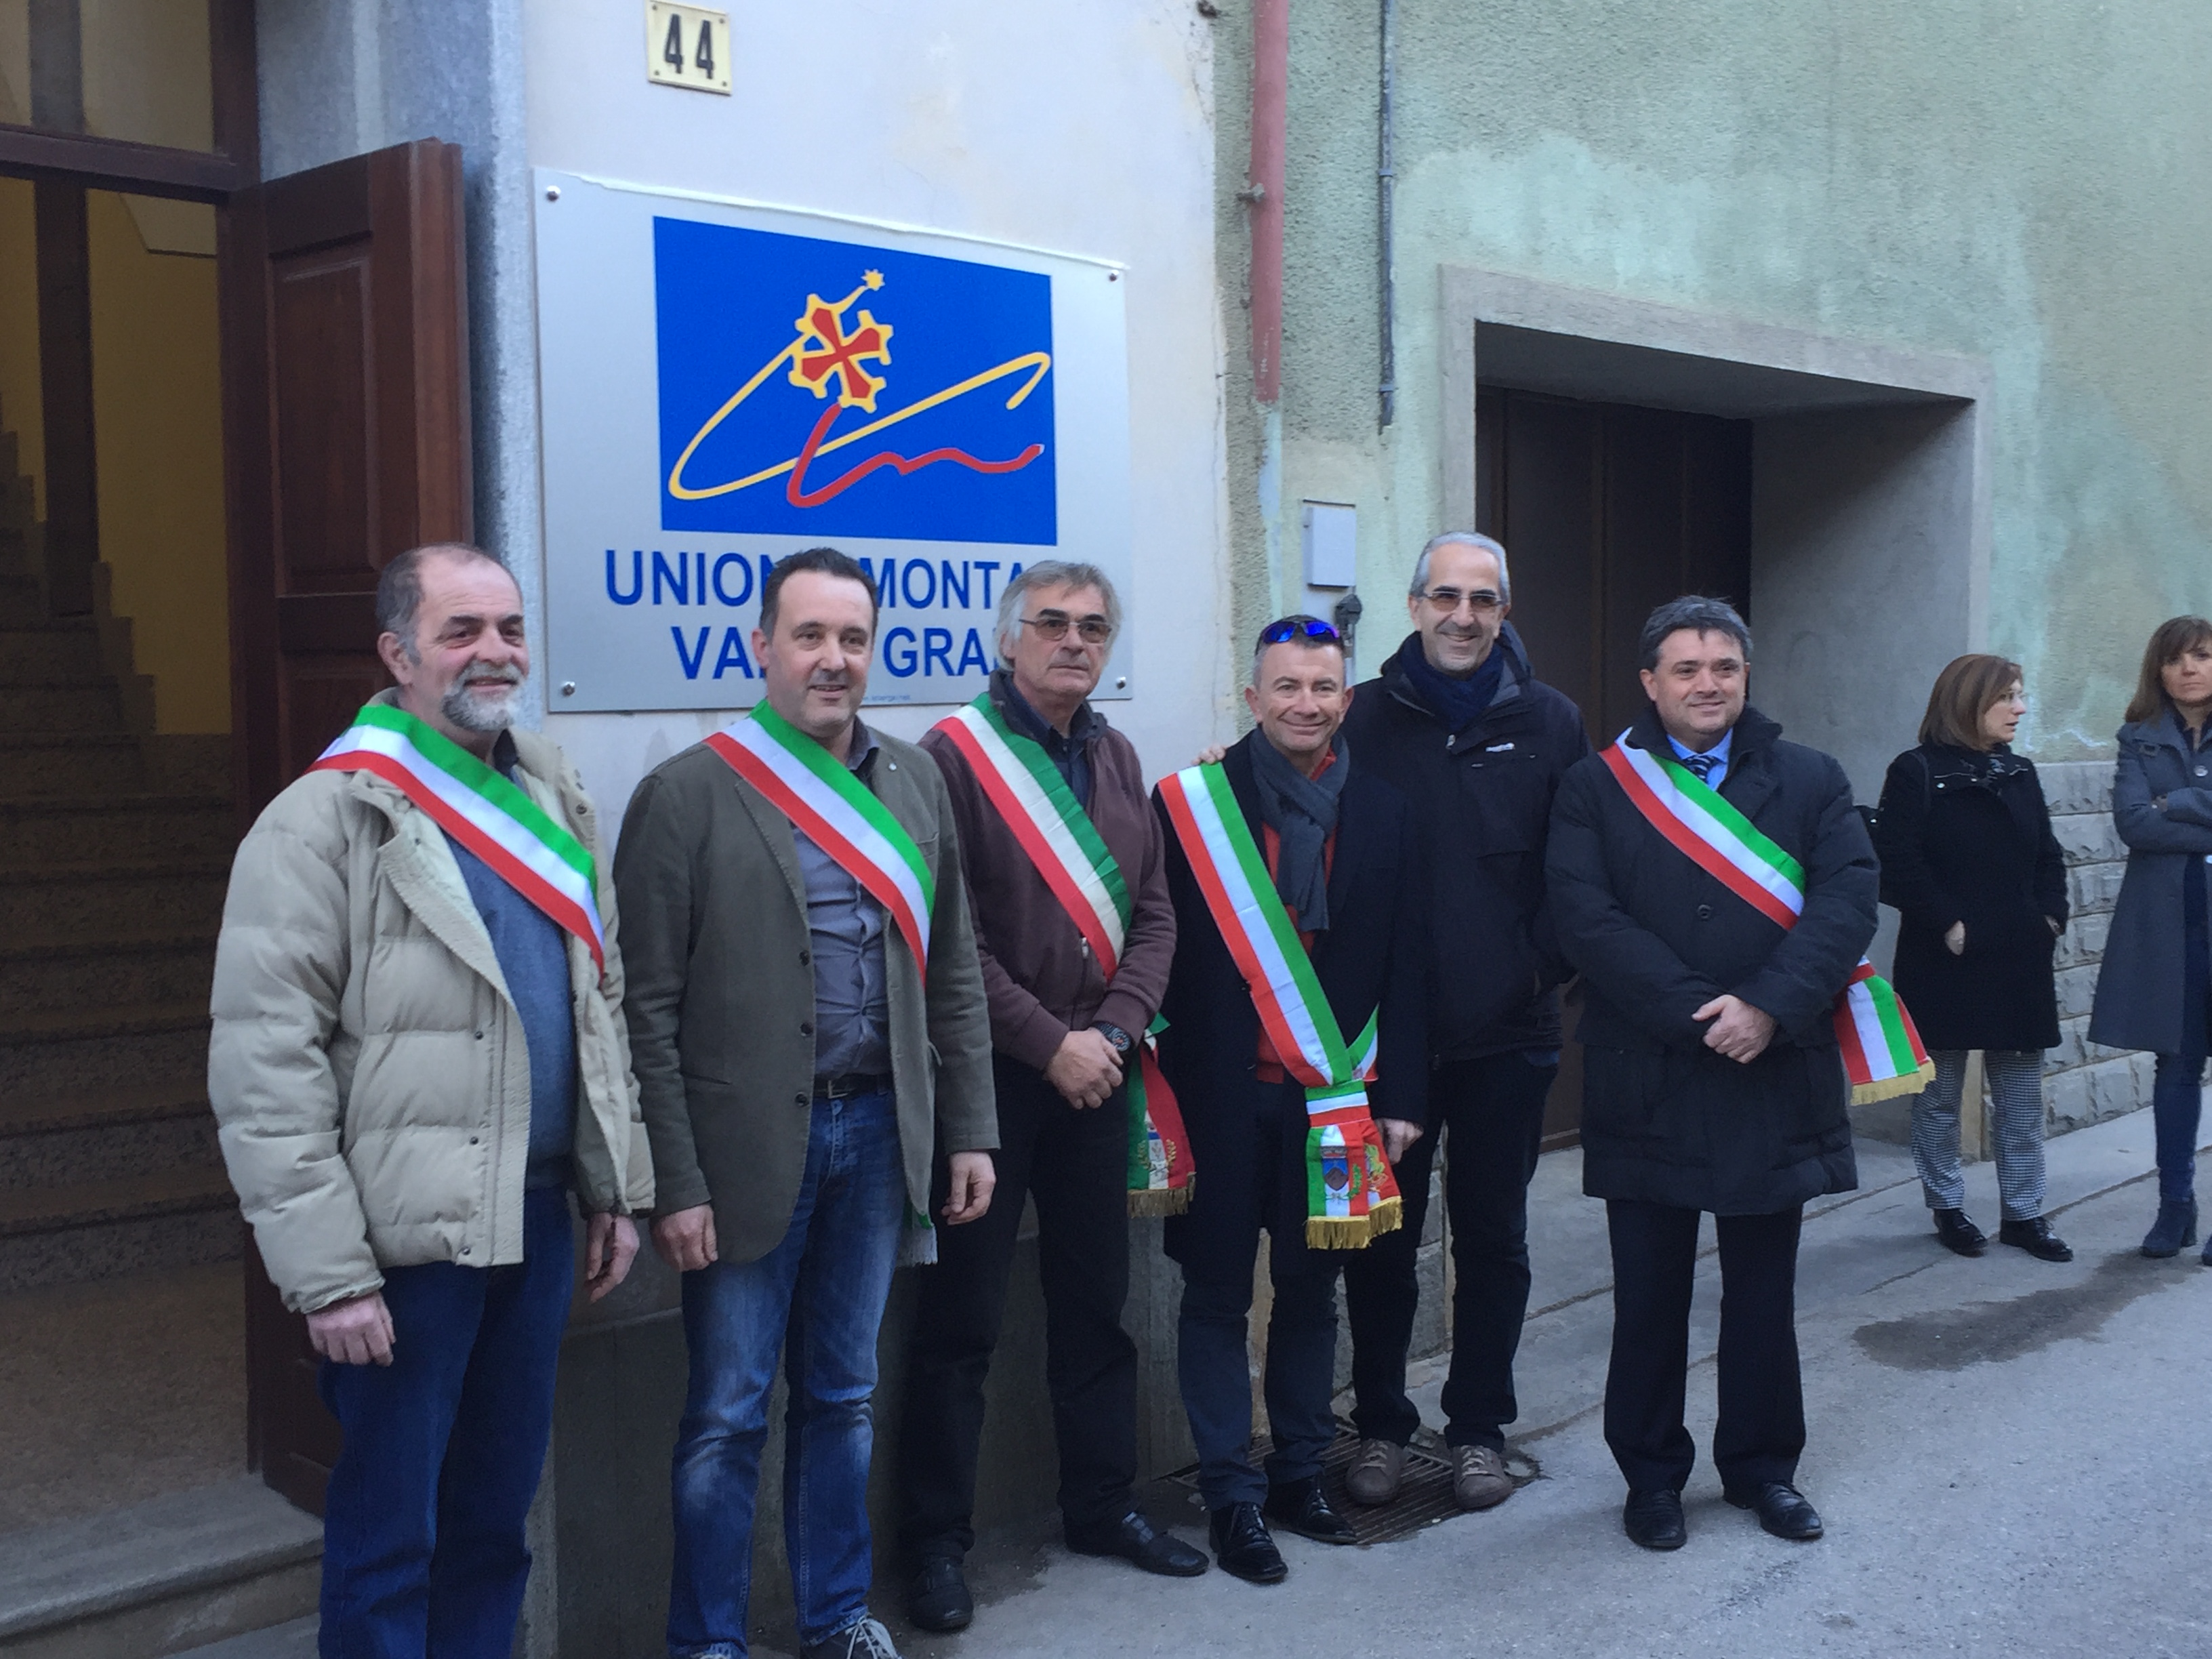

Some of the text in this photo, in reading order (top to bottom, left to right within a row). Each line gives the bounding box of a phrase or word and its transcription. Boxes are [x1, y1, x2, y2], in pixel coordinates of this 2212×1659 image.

[665, 14, 714, 80] 44
[670, 626, 999, 680] VA GRA
